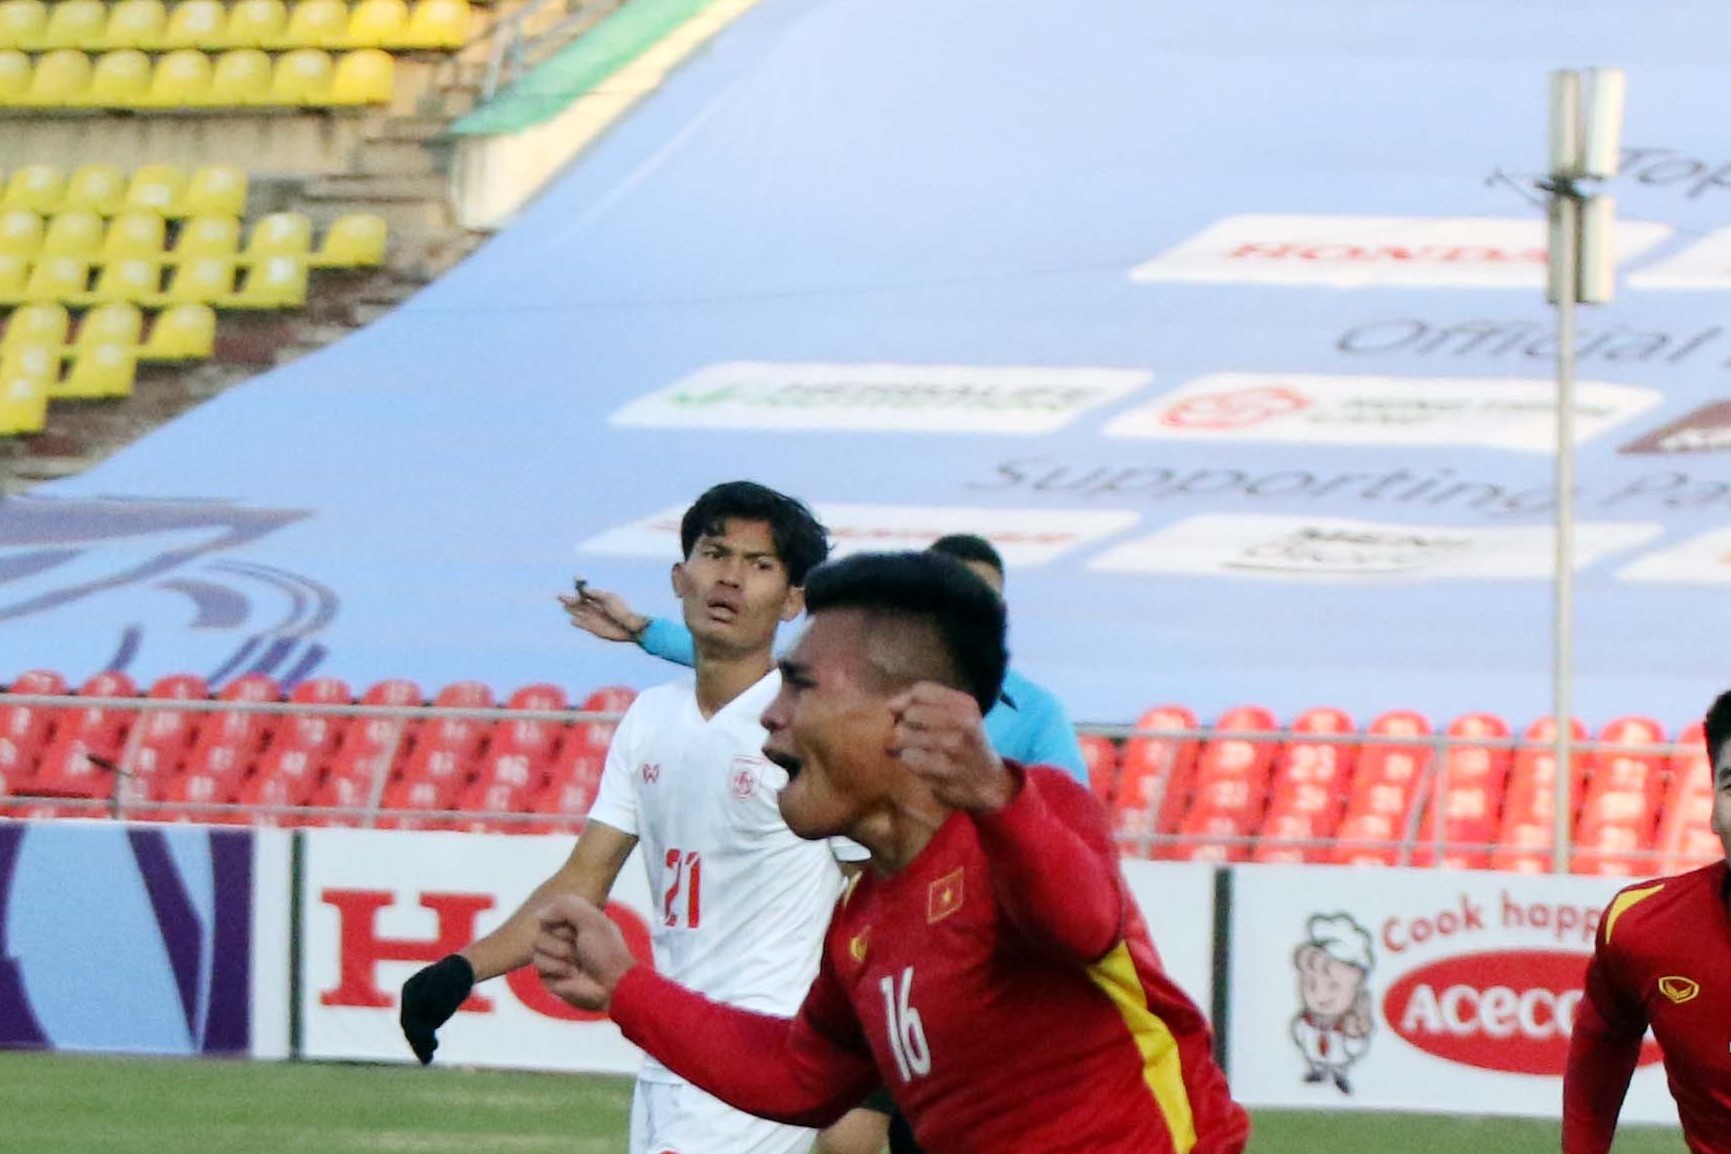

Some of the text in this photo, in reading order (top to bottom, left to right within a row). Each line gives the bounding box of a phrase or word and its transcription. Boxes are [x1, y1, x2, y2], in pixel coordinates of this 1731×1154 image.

[1336, 318, 1722, 363] Official
[962, 454, 1577, 518] Supporting
[663, 848, 702, 928] 21
[1382, 890, 1485, 954] Cook
[880, 965, 932, 1083] 16
